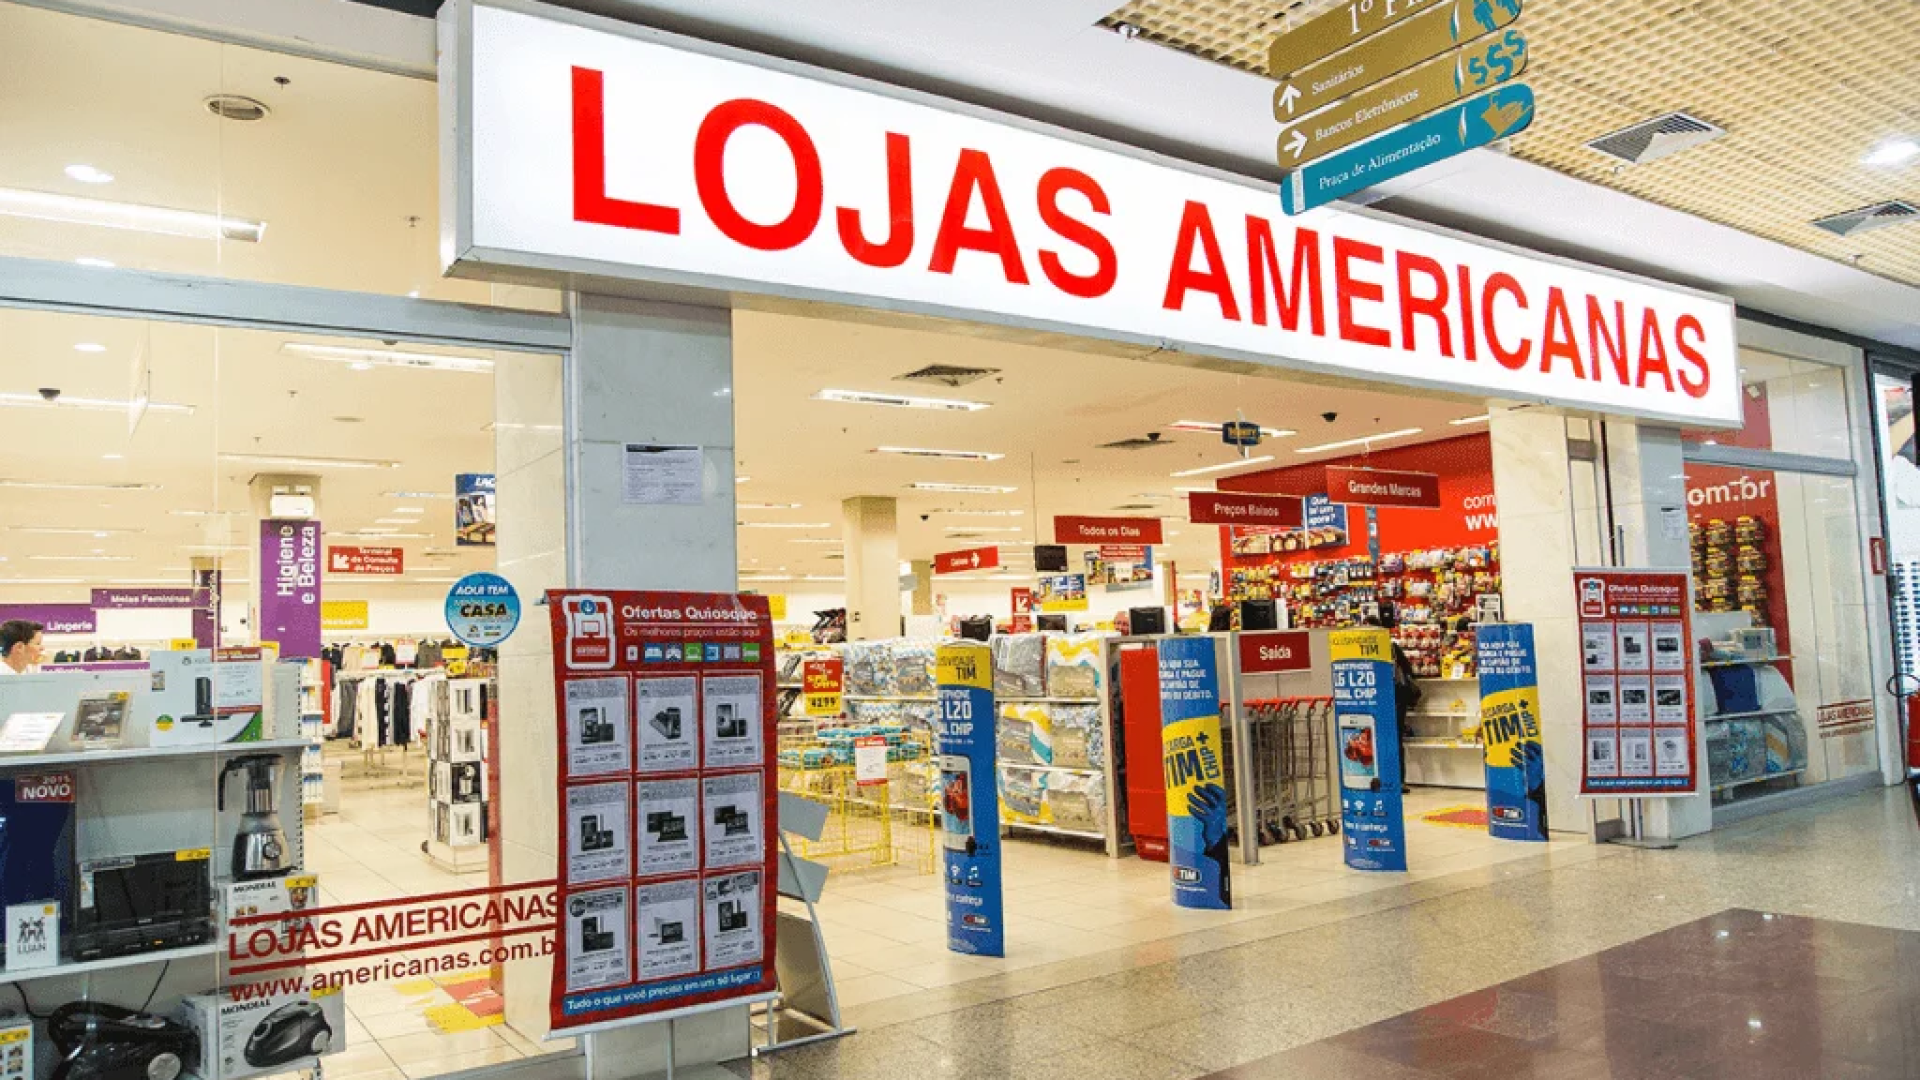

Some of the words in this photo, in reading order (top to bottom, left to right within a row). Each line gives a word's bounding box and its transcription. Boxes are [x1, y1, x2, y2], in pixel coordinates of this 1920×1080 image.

[1312, 65, 1364, 96] Sanitários
[1315, 118, 1353, 142] Bancos
[1355, 89, 1420, 124] Eletrônicos
[1319, 171, 1349, 191] Praça
[1351, 162, 1366, 178] de
[1368, 132, 1442, 172] Alimentação
[572, 66, 1118, 299] LOJAS
[1163, 200, 1711, 398] AMERICANAS
[1348, 478, 1387, 496] Grandes
[1389, 483, 1422, 498] Marcas
[1214, 503, 1247, 518] Preços
[1249, 504, 1280, 517] Baixos
[1079, 524, 1107, 537] Todos
[1108, 528, 1119, 537] os
[1121, 525, 1141, 537] Dias
[276, 525, 299, 597] Higiene
[298, 526, 316, 587] Beleza
[455, 584, 485, 596] AQUI
[487, 584, 509, 596] TEM
[1608, 584, 1639, 594] Ofertas
[1640, 584, 1680, 595] Quiosque
[111, 594, 140, 604] Meias
[142, 593, 191, 604] Femininas
[302, 592, 316, 605] e
[460, 603, 508, 618] CASA
[622, 605, 682, 620] Ofertas
[685, 604, 758, 622] Quiosque
[47, 619, 94, 633] Lingerie
[624, 626, 638, 637] Os
[683, 627, 714, 639] preços
[716, 626, 741, 637] estão
[743, 627, 760, 638] aqui
[1259, 646, 1292, 660] Saída
[1360, 644, 1380, 657] TIM
[955, 667, 978, 681] TIM
[1348, 671, 1376, 687] L20
[1354, 688, 1378, 700] CHIP
[950, 723, 974, 736] CHIP
[1484, 712, 1525, 746] TIM
[22, 784, 71, 800] NOVO
[1180, 869, 1197, 880] TIM
[228, 919, 343, 961] LOJAS
[350, 891, 558, 946] AMERICANAS
[18, 942, 47, 955] LUAN
[568, 999, 593, 1011] Tudo
[594, 999, 601, 1007] o
[603, 997, 622, 1007] que
[623, 990, 648, 1002] você
[684, 981, 700, 991] em
[701, 978, 716, 989] um
[717, 976, 730, 986] só
